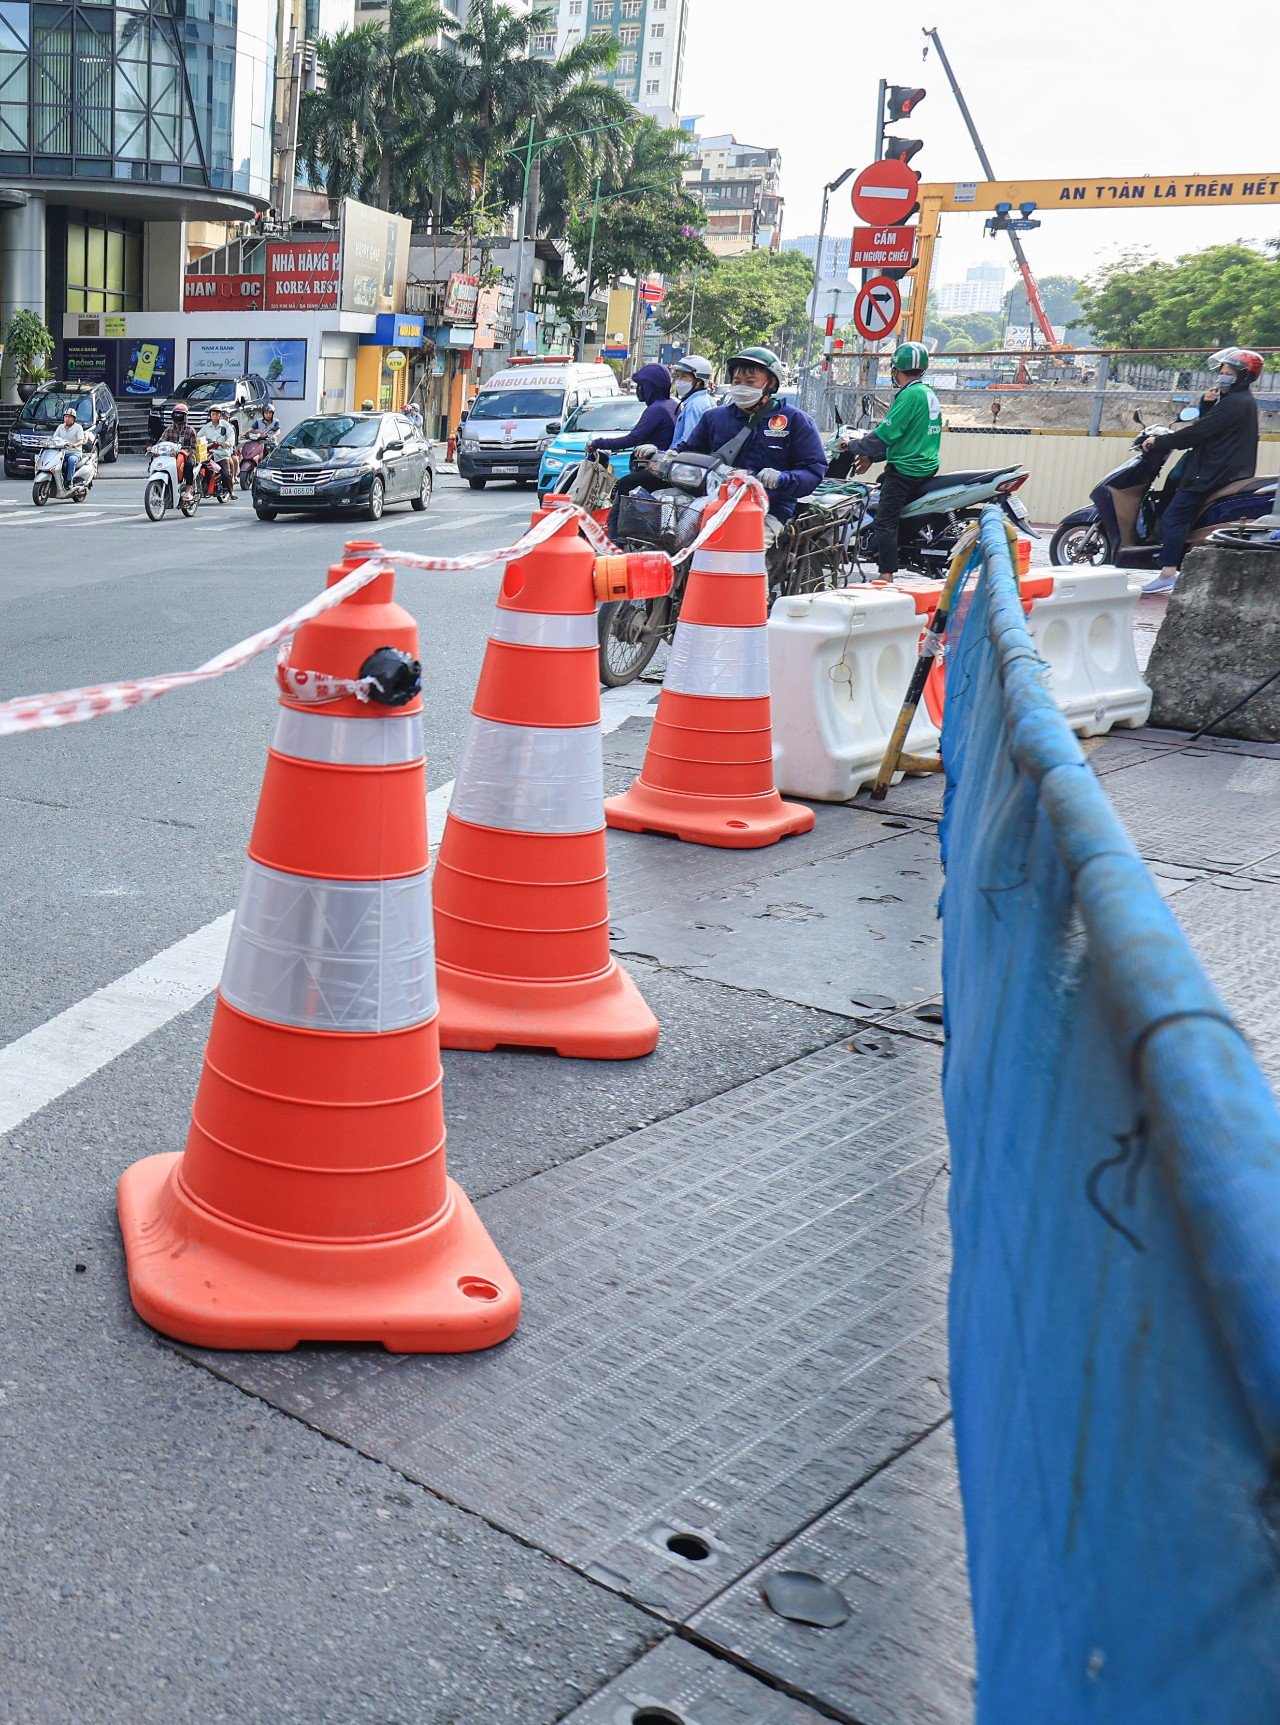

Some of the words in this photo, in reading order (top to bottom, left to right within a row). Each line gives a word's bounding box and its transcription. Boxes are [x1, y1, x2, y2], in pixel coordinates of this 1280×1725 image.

[1059, 186, 1087, 200] AN
[1153, 180, 1177, 198] LÀ
[1184, 179, 1234, 197] TRÊN
[1241, 176, 1280, 196] HẾT
[873, 228, 897, 245] CẤM
[272, 249, 296, 272] NHÀ
[298, 249, 330, 272] HÀNG
[854, 251, 862, 262] ĐI
[862, 250, 887, 264] NGƯỢC
[185, 282, 217, 297] HAN
[275, 280, 311, 295] KOREA
[485, 376, 565, 389] AMBULANCE
